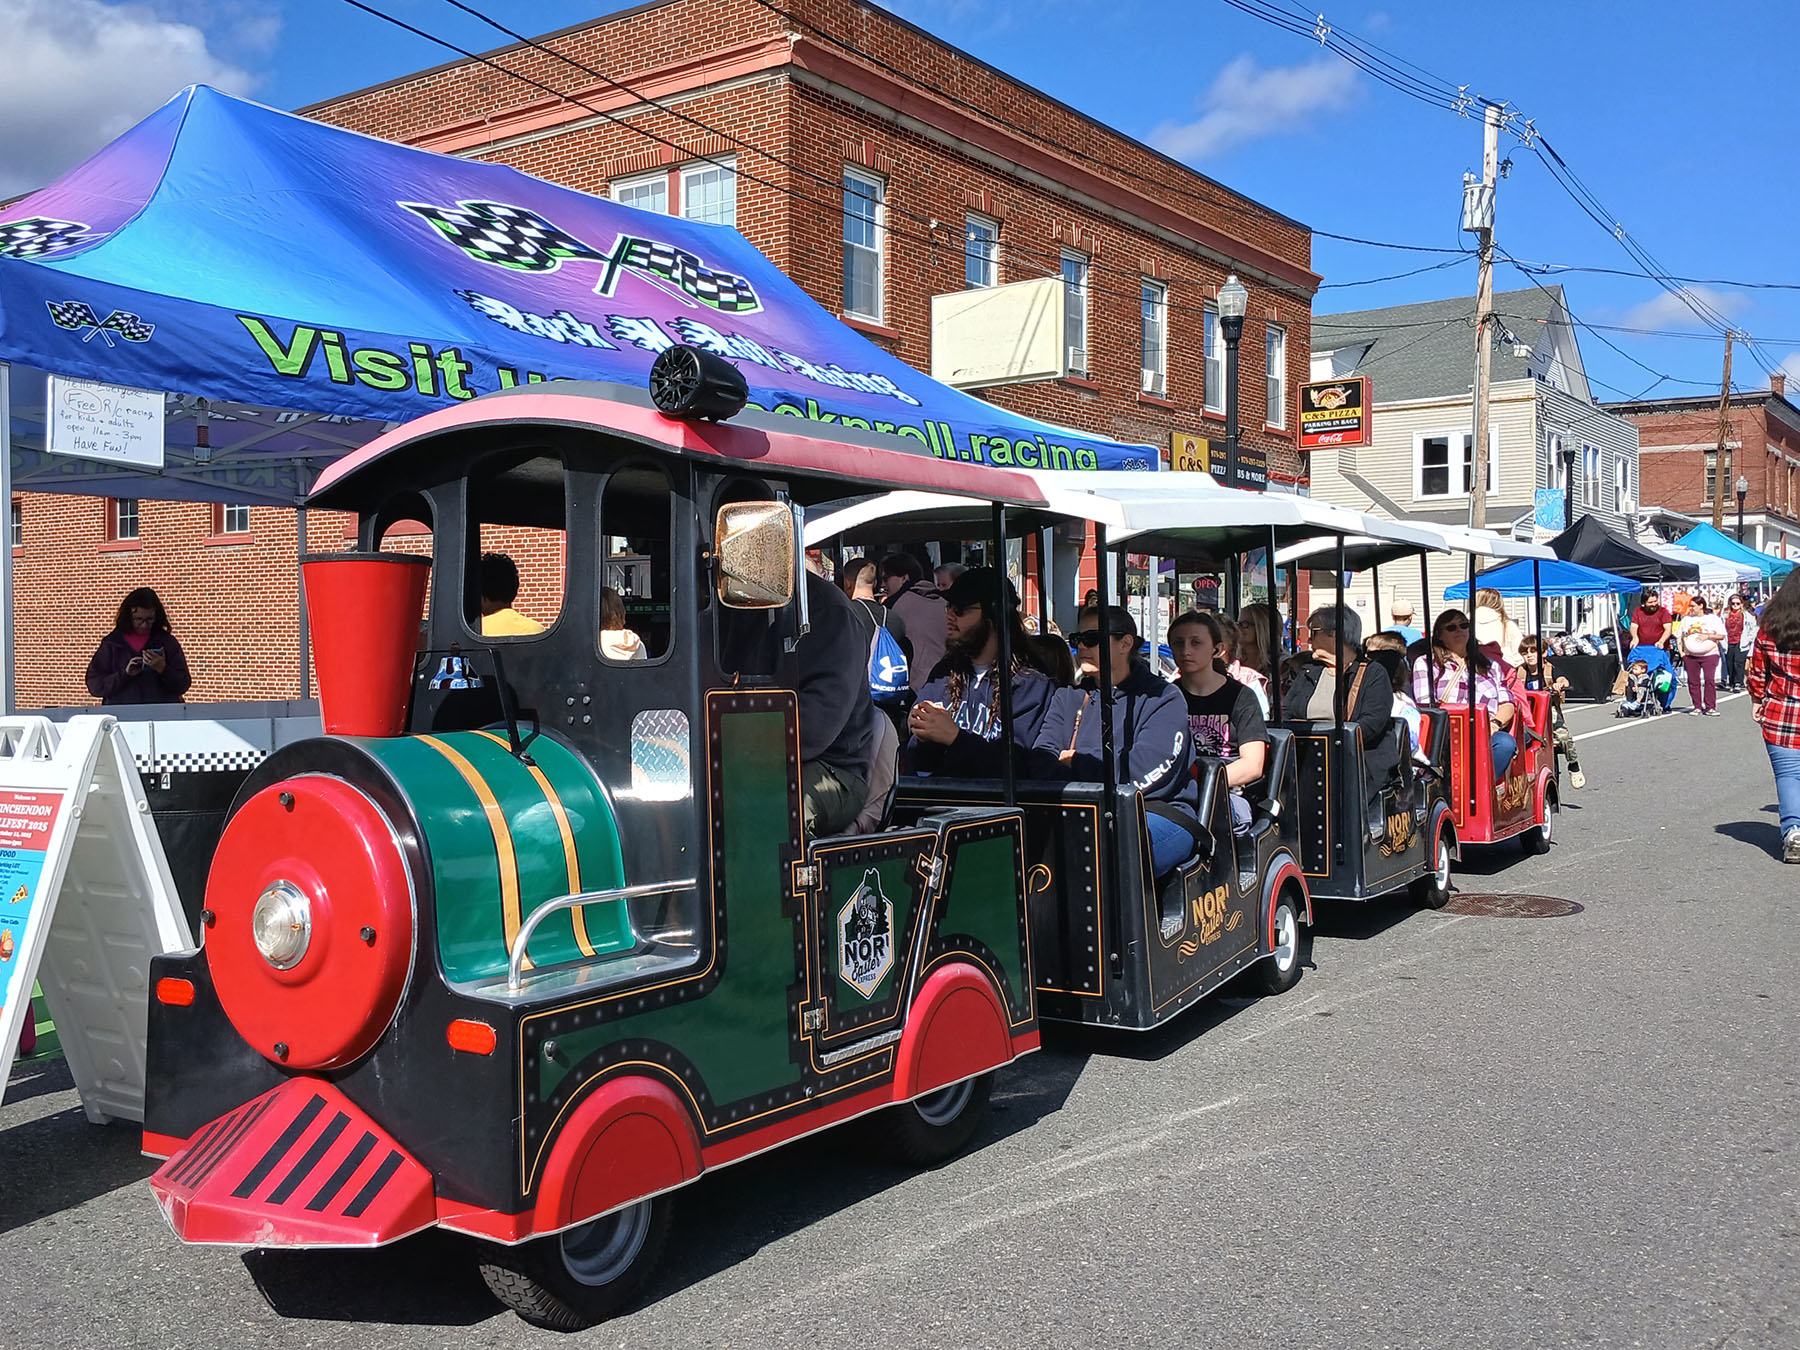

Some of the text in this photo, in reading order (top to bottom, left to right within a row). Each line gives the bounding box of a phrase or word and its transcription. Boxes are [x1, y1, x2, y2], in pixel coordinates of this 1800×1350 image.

[235, 314, 475, 400] Visit
[67, 392, 97, 411] Free
[126, 407, 154, 421] racing
[1304, 408, 1357, 420] C&S PIZZA
[66, 424, 86, 432] open
[77, 412, 96, 423] kids
[108, 417, 135, 429] adults
[73, 436, 128, 455] Have Fun!
[1179, 456, 1203, 472] C&S
[1251, 472, 1266, 483] MORE
[1194, 579, 1219, 590] OPEN
[161, 773, 169, 788] 4
[0, 803, 53, 816] INCHENDON
